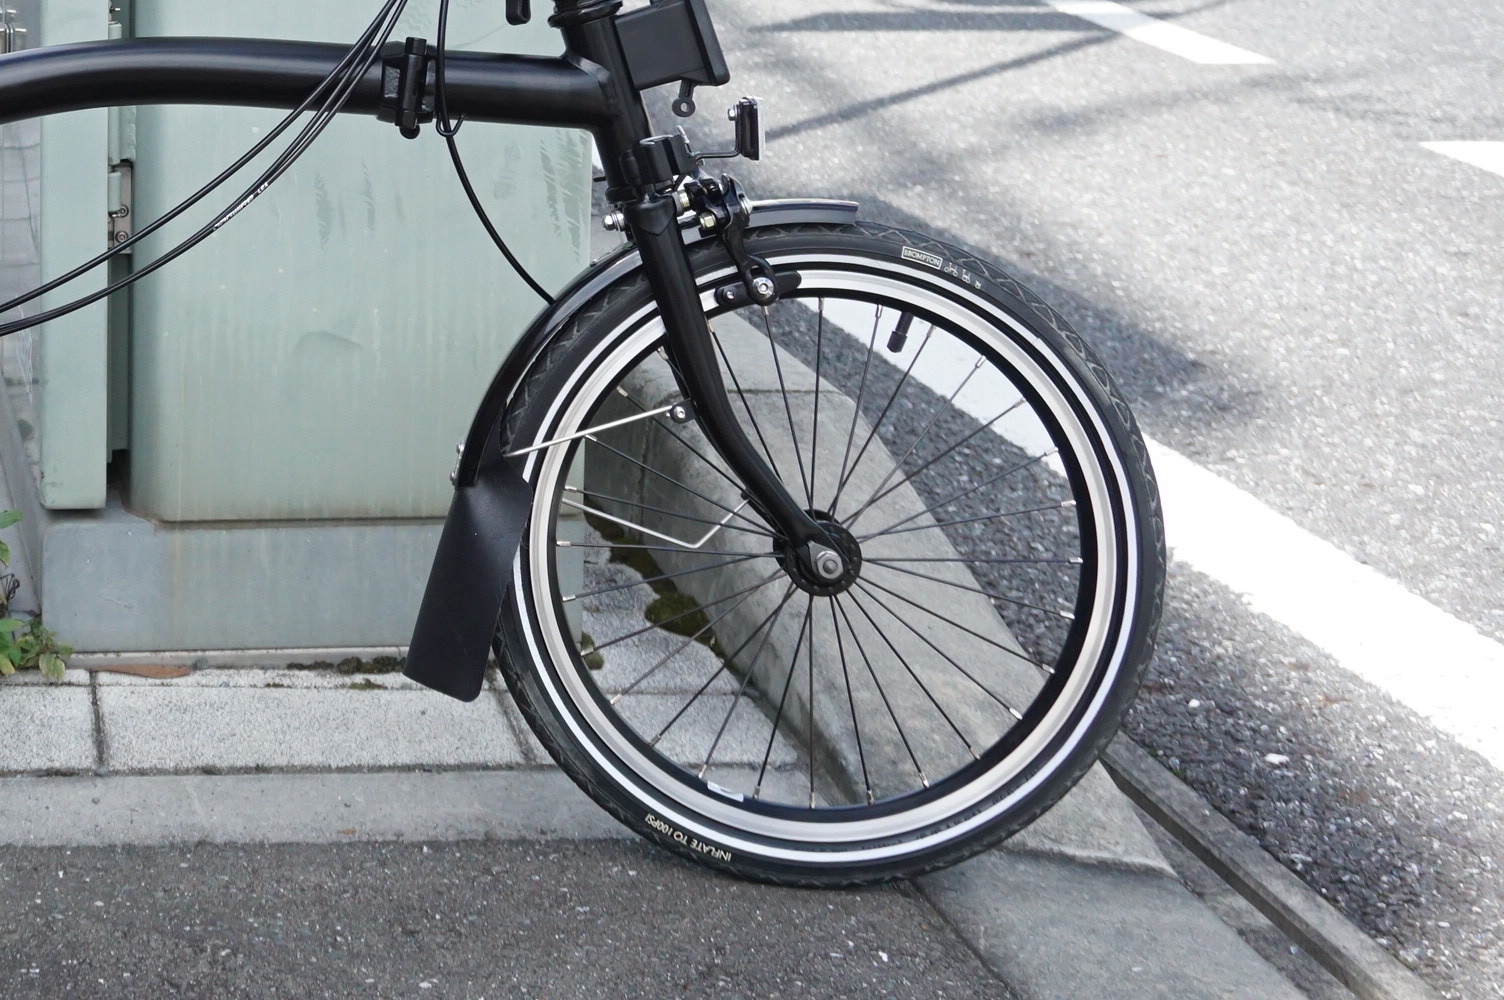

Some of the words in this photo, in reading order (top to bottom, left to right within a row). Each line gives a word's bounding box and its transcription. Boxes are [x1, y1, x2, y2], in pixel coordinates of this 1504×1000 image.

[903, 249, 941, 267] BROMPTON
[645, 813, 674, 836] 100PSI
[673, 831, 689, 846] TO
[690, 839, 732, 862] INFLATE
